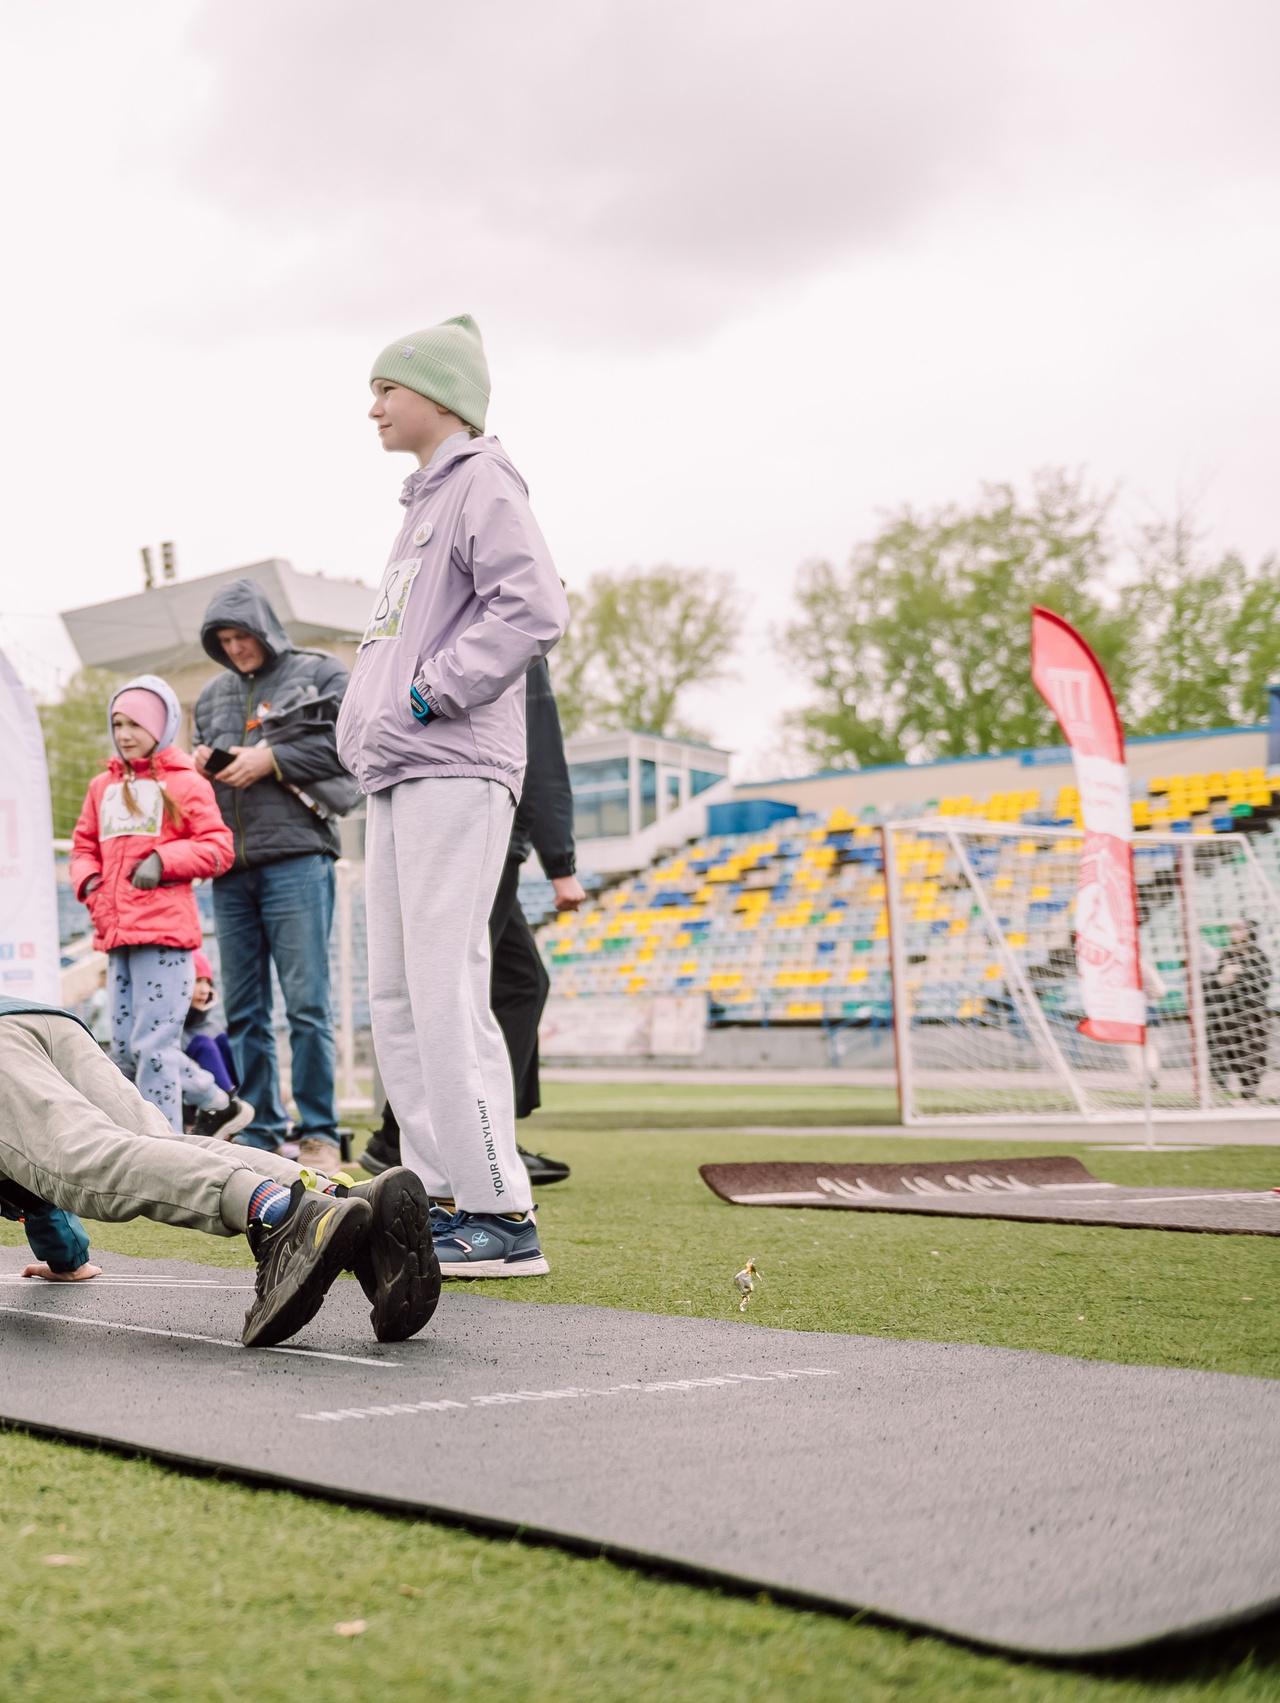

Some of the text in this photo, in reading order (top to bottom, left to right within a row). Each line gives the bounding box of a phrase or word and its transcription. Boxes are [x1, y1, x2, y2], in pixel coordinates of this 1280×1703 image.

[374, 569, 400, 622] 8
[476, 1098, 505, 1197] YOUR ONLYLIMIT
